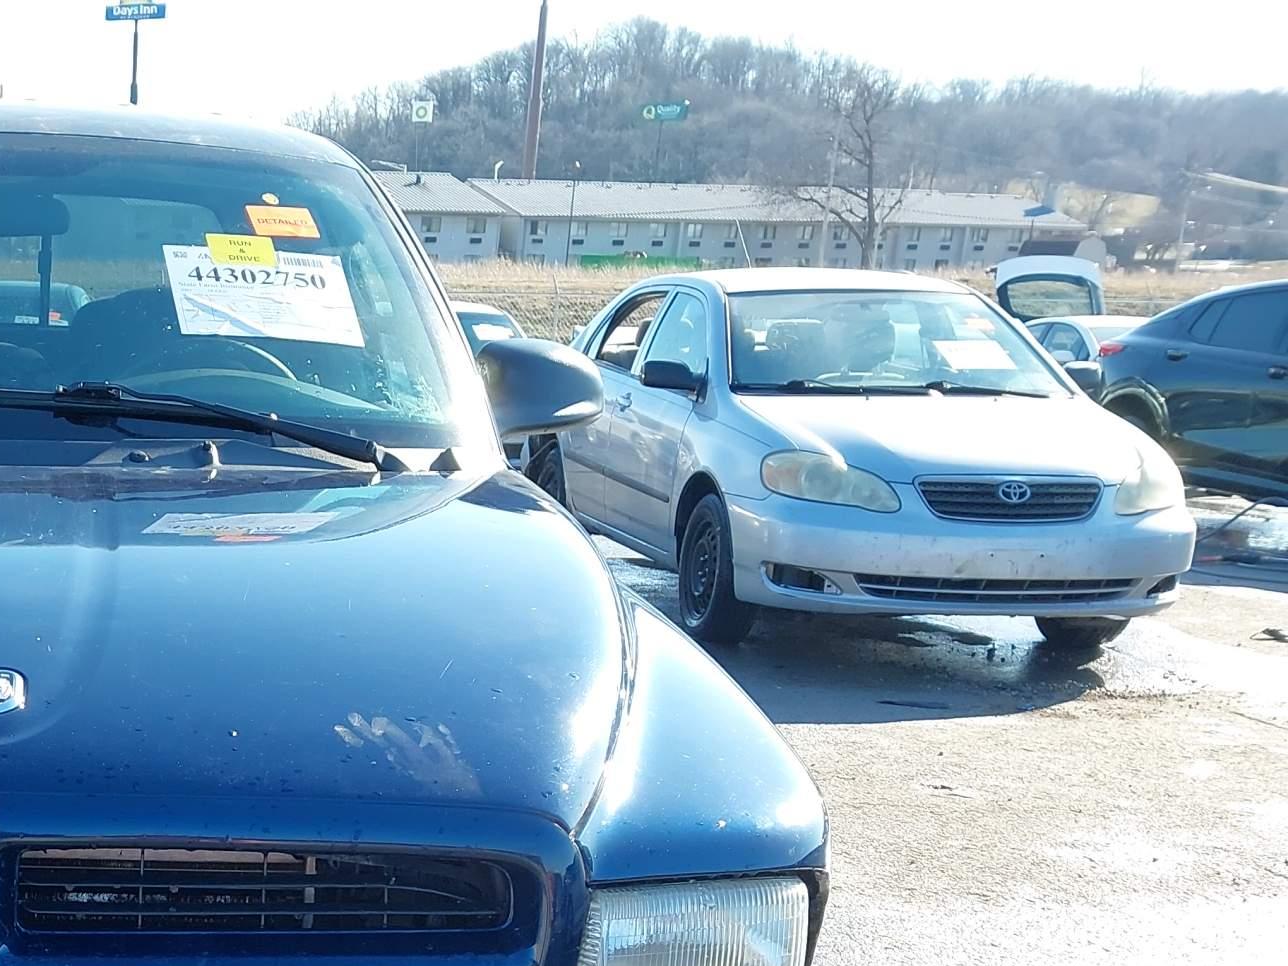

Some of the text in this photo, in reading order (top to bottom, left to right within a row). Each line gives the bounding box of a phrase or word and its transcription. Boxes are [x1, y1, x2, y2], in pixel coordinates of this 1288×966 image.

[256, 217, 309, 225] DETAILED
[228, 239, 252, 247] RUN
[228, 254, 261, 262] DRIVE
[188, 266, 326, 289] 44302750
